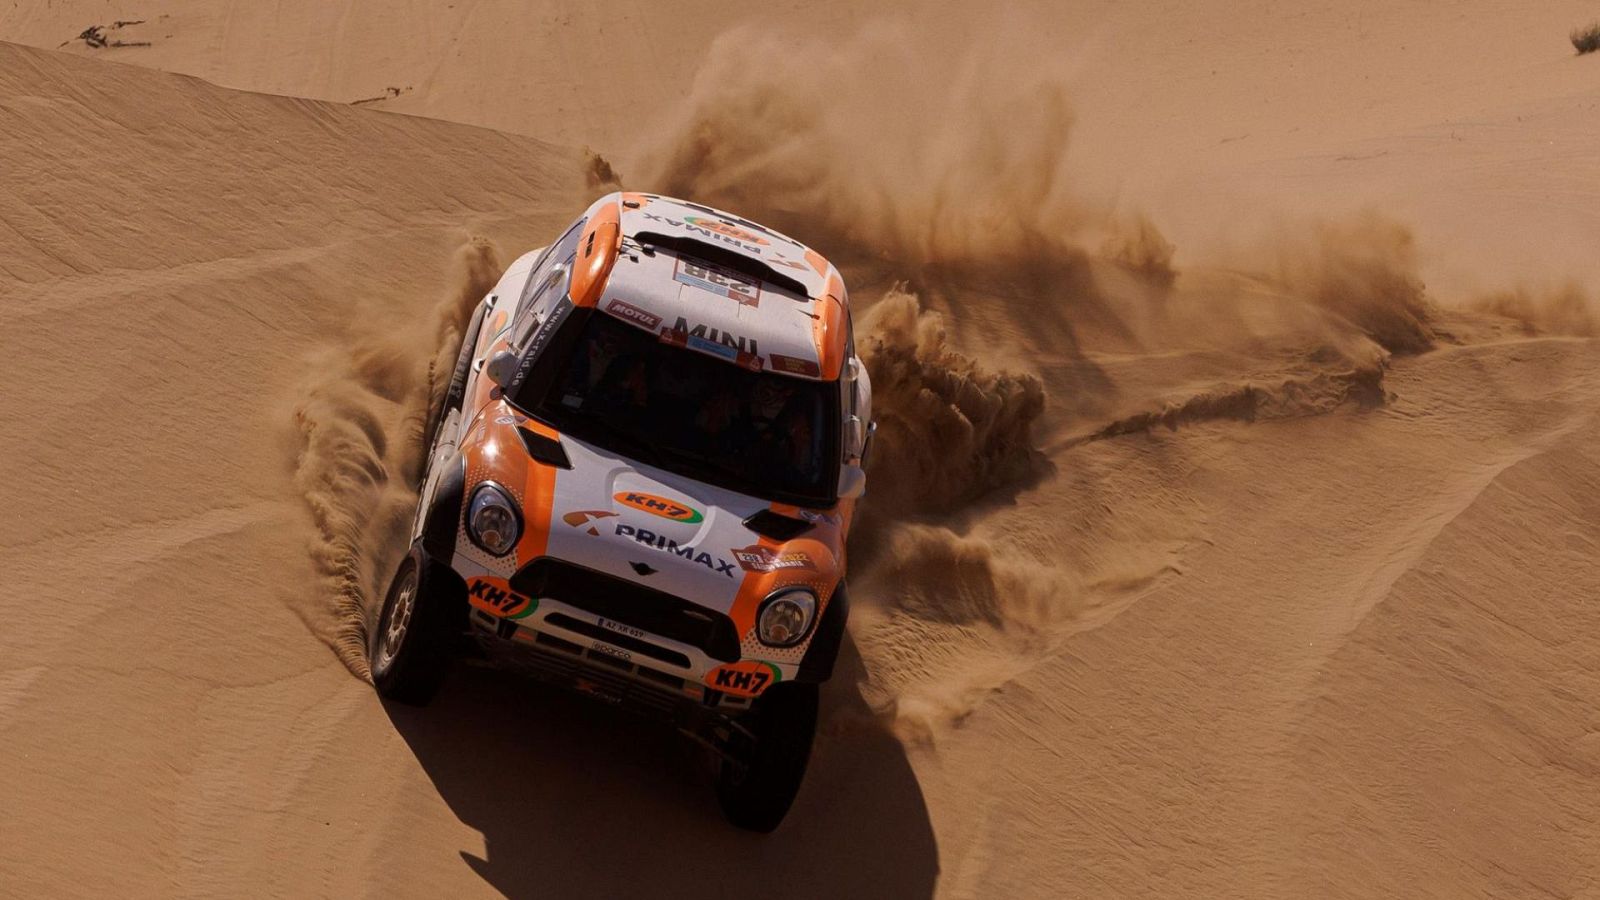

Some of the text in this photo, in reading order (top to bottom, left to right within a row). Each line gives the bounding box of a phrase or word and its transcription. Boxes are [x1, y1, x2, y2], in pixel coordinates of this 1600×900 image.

[643, 212, 761, 254] PRIMAX
[685, 263, 750, 294] 238
[611, 303, 656, 326] MOTUL
[511, 306, 566, 386] www.x-raid.de
[673, 316, 758, 357] MINI
[614, 523, 737, 579] PRIMAX
